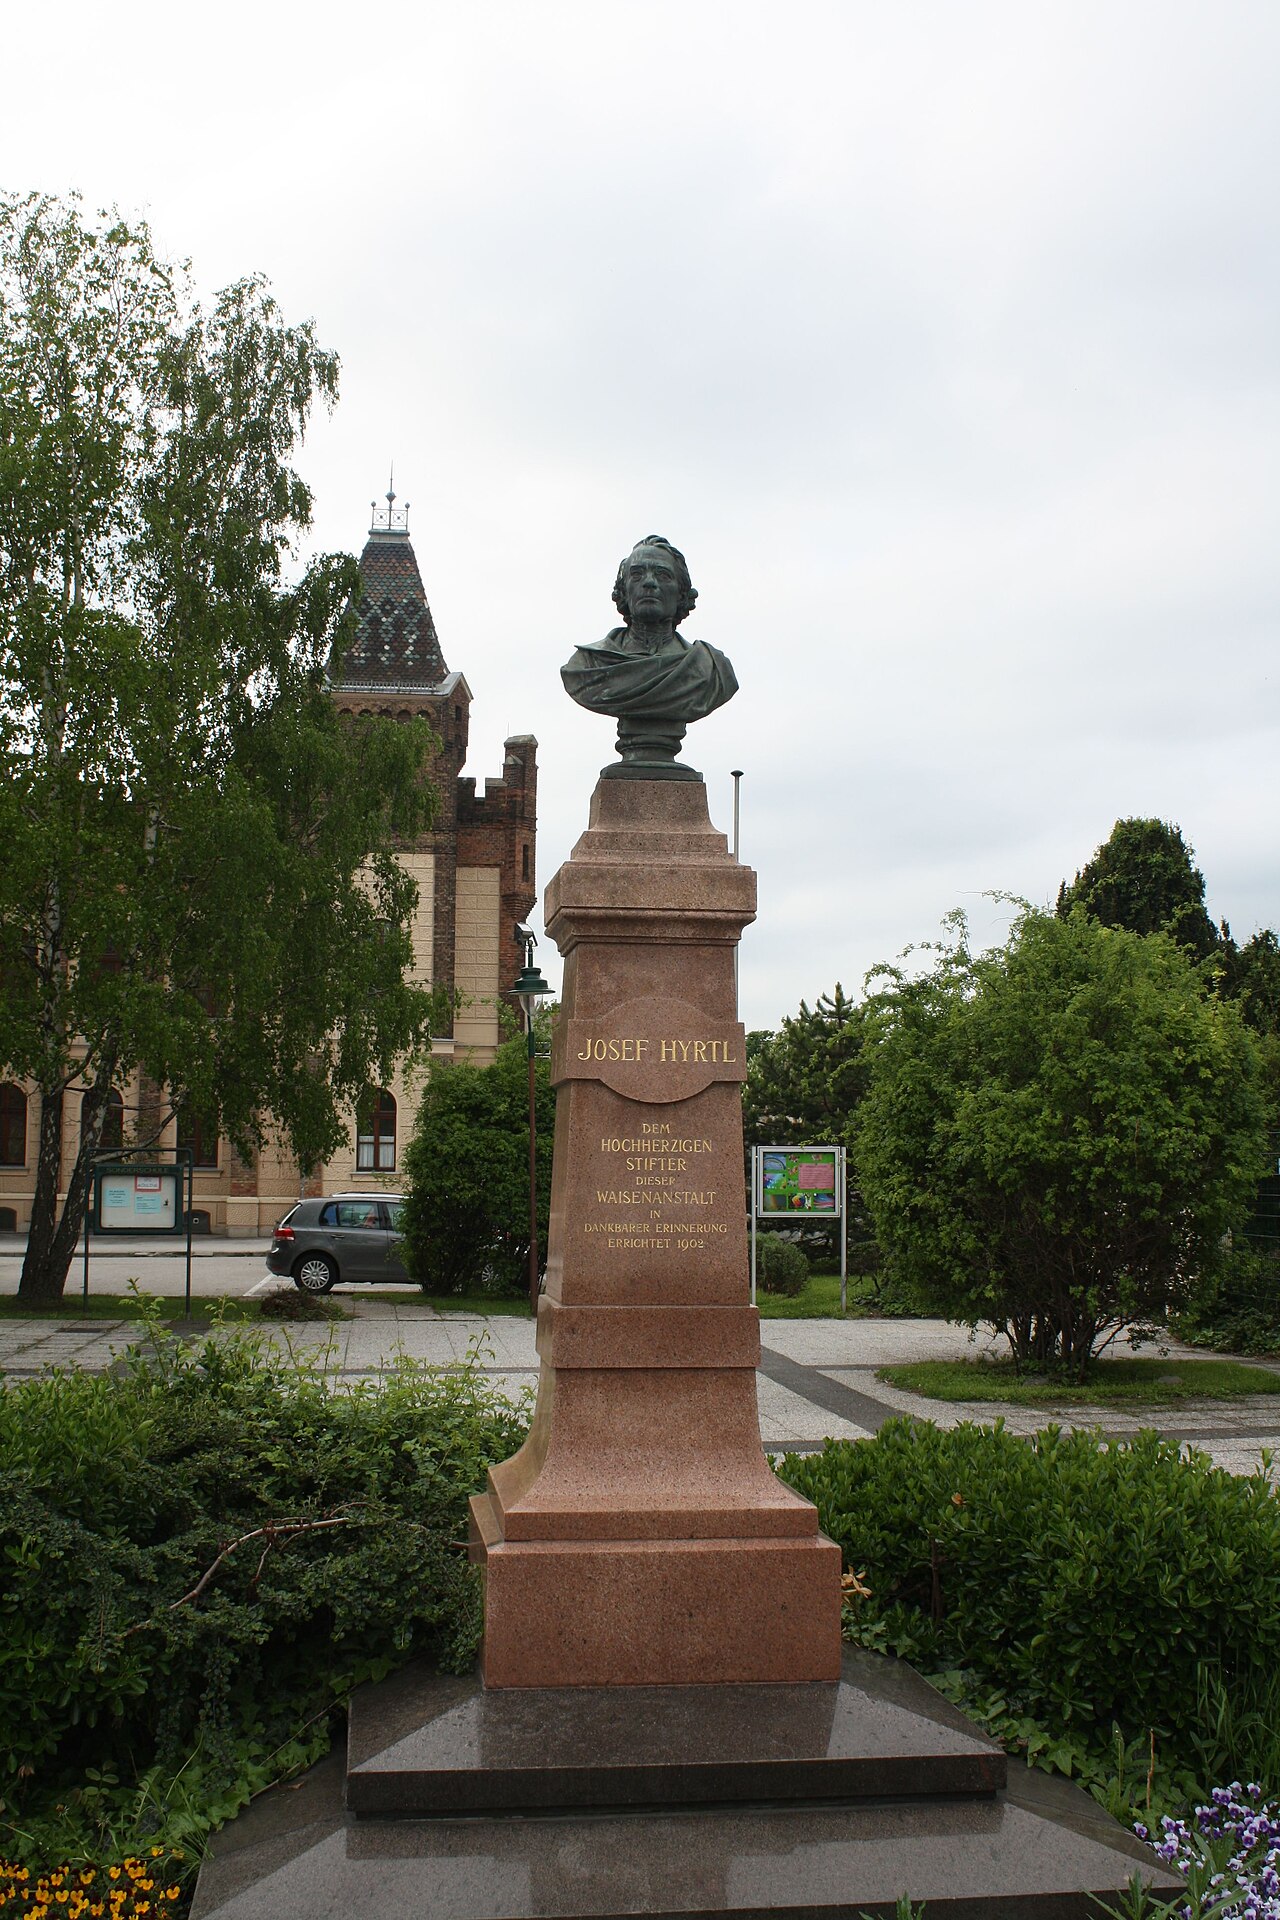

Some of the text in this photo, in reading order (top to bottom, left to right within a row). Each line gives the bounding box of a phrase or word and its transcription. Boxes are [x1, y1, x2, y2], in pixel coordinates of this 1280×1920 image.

[578, 1039, 736, 1063] JOSEF HYRTL
[642, 1123, 670, 1134] DEM
[601, 1139, 712, 1152] HOCHHERZIGEN
[626, 1157, 687, 1171] STIFTER
[636, 1176, 676, 1186] DIESER
[596, 1190, 717, 1205] WAISENANSTALT
[650, 1210, 661, 1219] IN
[584, 1223, 728, 1233] DANKBARER ERINNERUNG
[608, 1238, 704, 1251] ERRICHTET 1902
